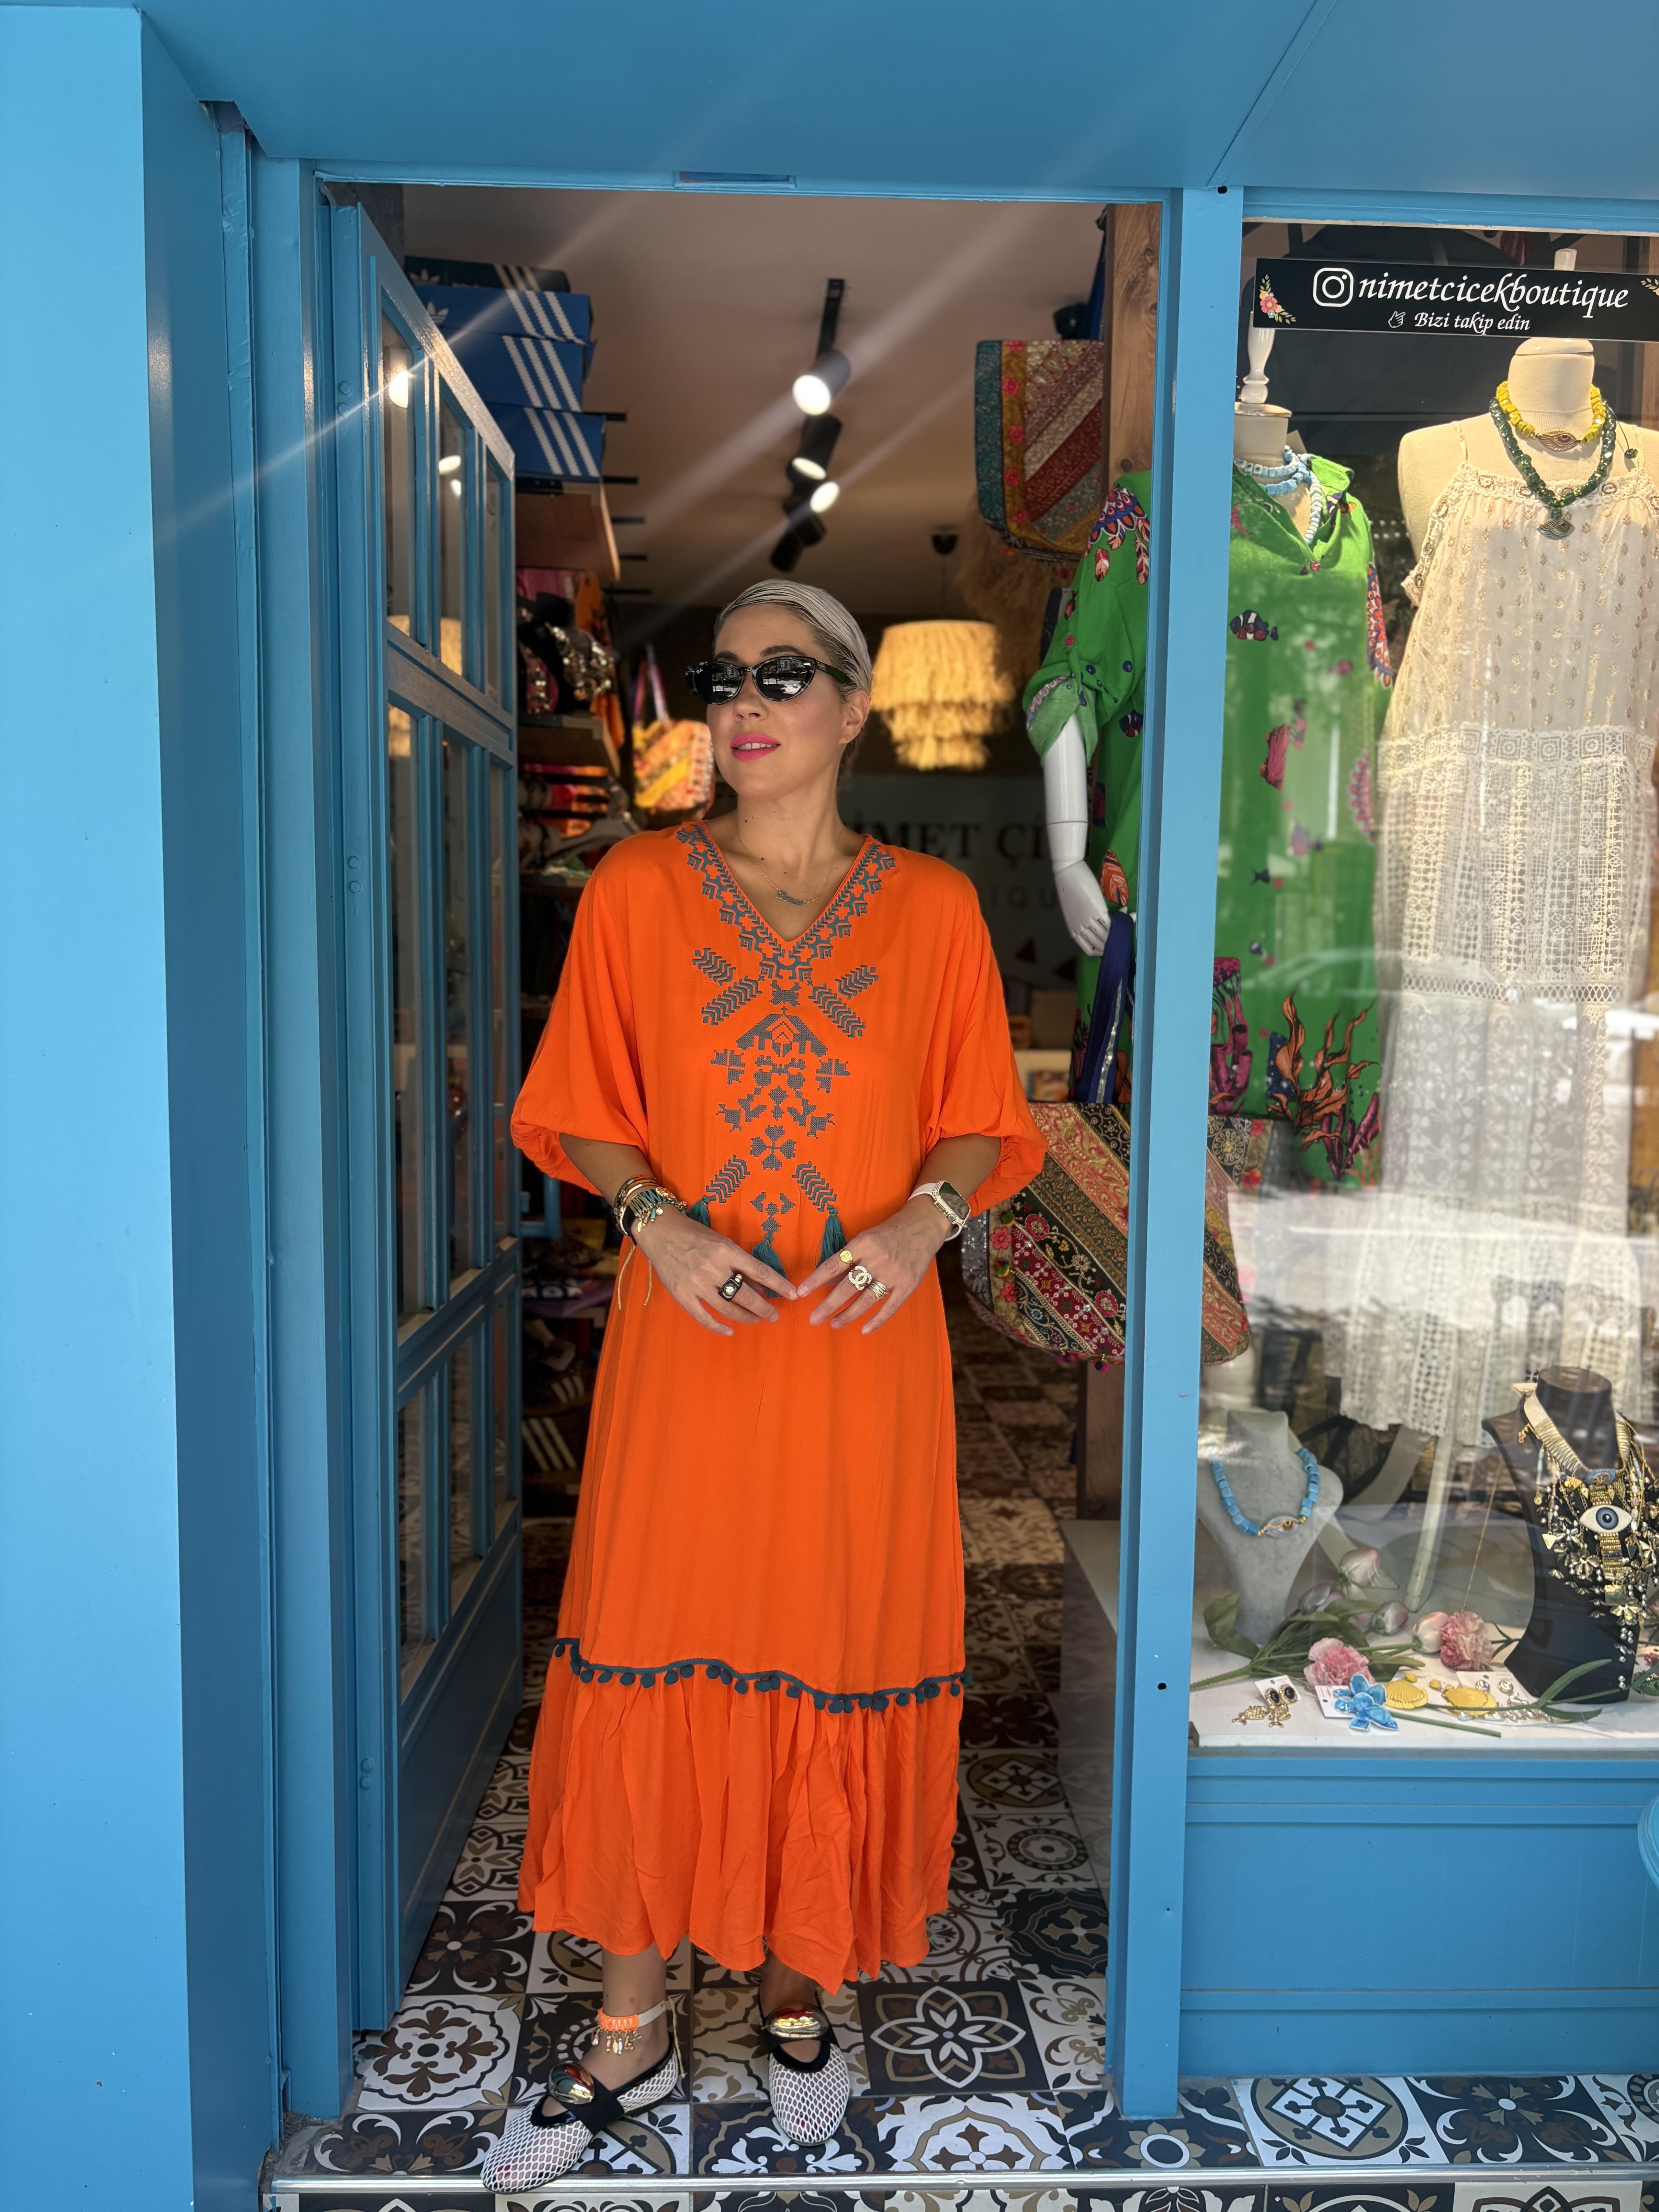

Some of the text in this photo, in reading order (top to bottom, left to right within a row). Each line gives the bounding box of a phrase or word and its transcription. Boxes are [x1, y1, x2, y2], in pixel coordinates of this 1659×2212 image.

[1358, 272, 1628, 318] nimetcicekboutique
[1414, 311, 1530, 335] Bizi takip edin
